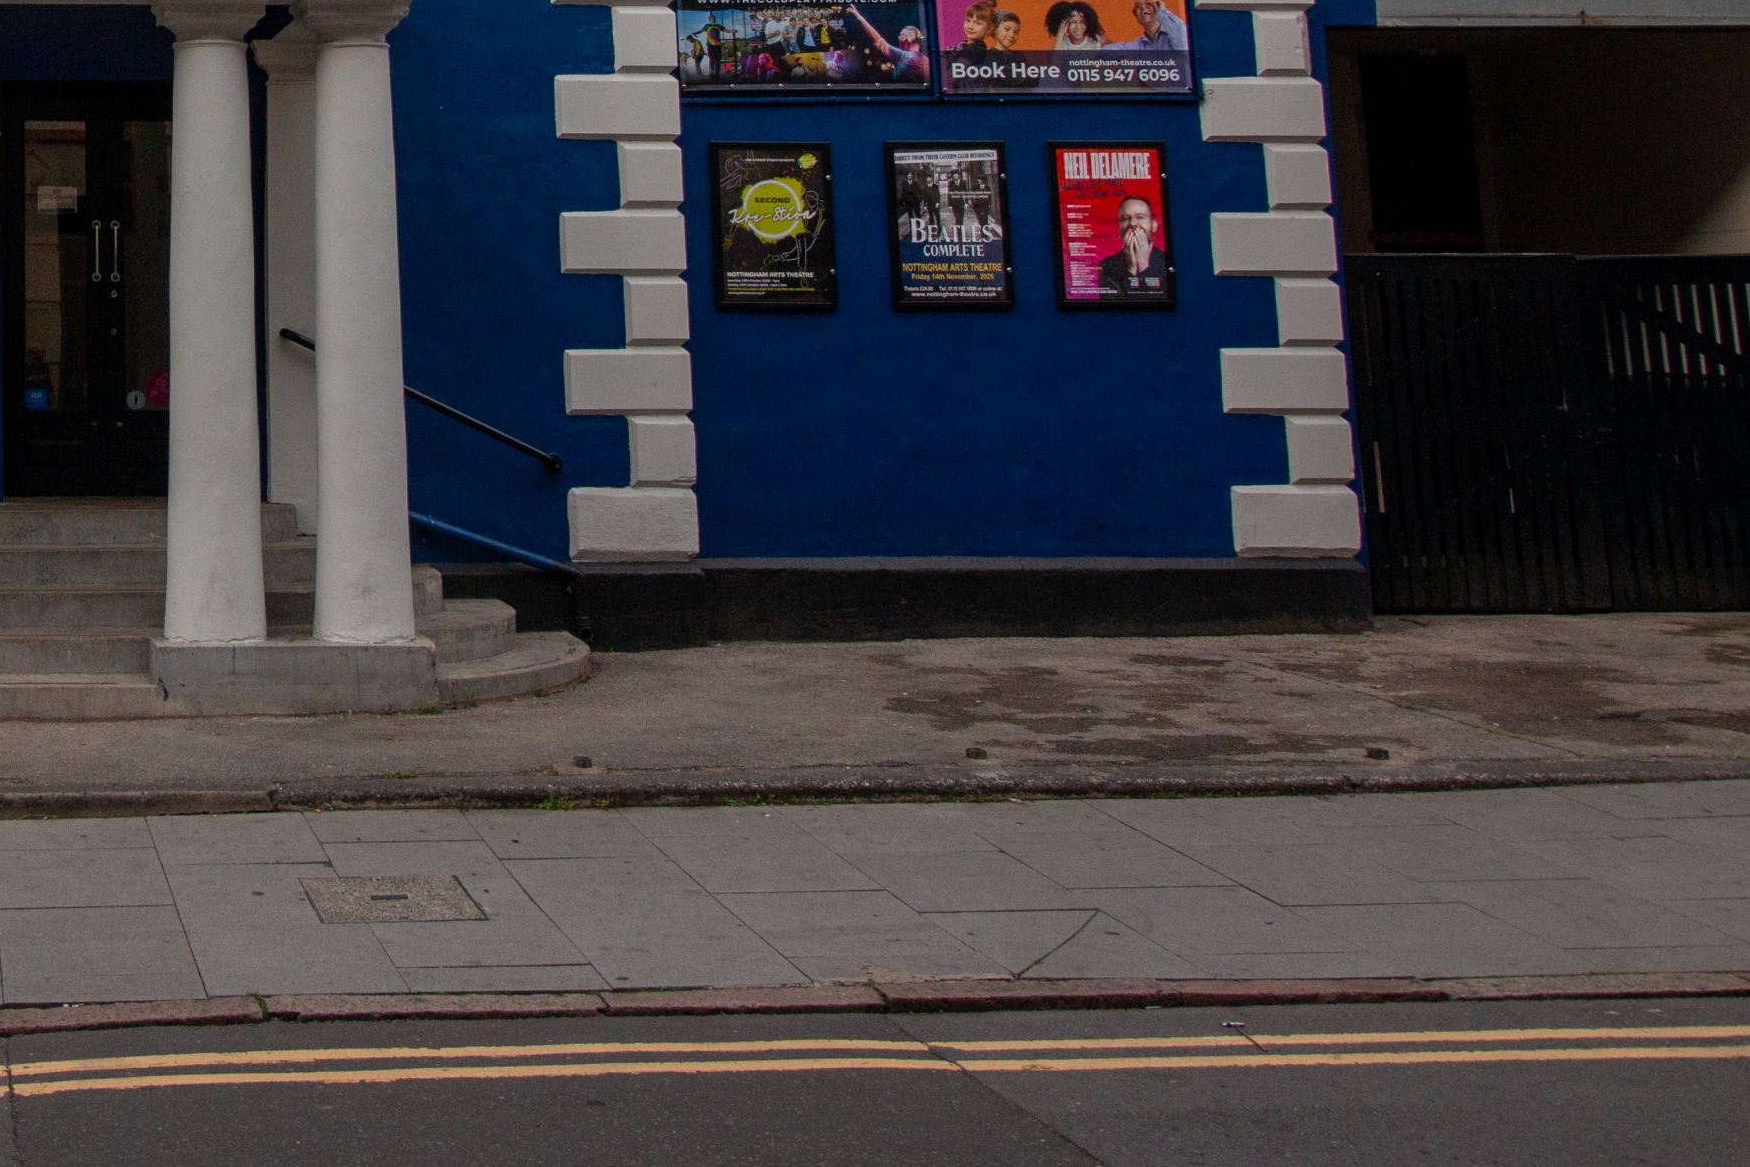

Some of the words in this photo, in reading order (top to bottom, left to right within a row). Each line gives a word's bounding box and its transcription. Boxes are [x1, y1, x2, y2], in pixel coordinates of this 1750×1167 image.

[1069, 58, 1176, 68] nottingham-theatre.co.uk
[951, 62, 1006, 78] Book
[1011, 62, 1061, 78] Here
[1067, 69, 1100, 82] 0115
[1103, 69, 1134, 82] 947
[1139, 69, 1180, 82] 6096
[1063, 152, 1090, 179] NEIL
[1090, 152, 1151, 179] DELAMERE
[754, 196, 791, 204] SECOND
[910, 218, 994, 243] BEATLES
[923, 244, 985, 257] COMPLETE
[902, 263, 948, 272] NOTTINGHAM
[949, 263, 968, 272] ARTS
[969, 263, 1003, 272] THEATRE
[911, 273, 930, 281] Friday
